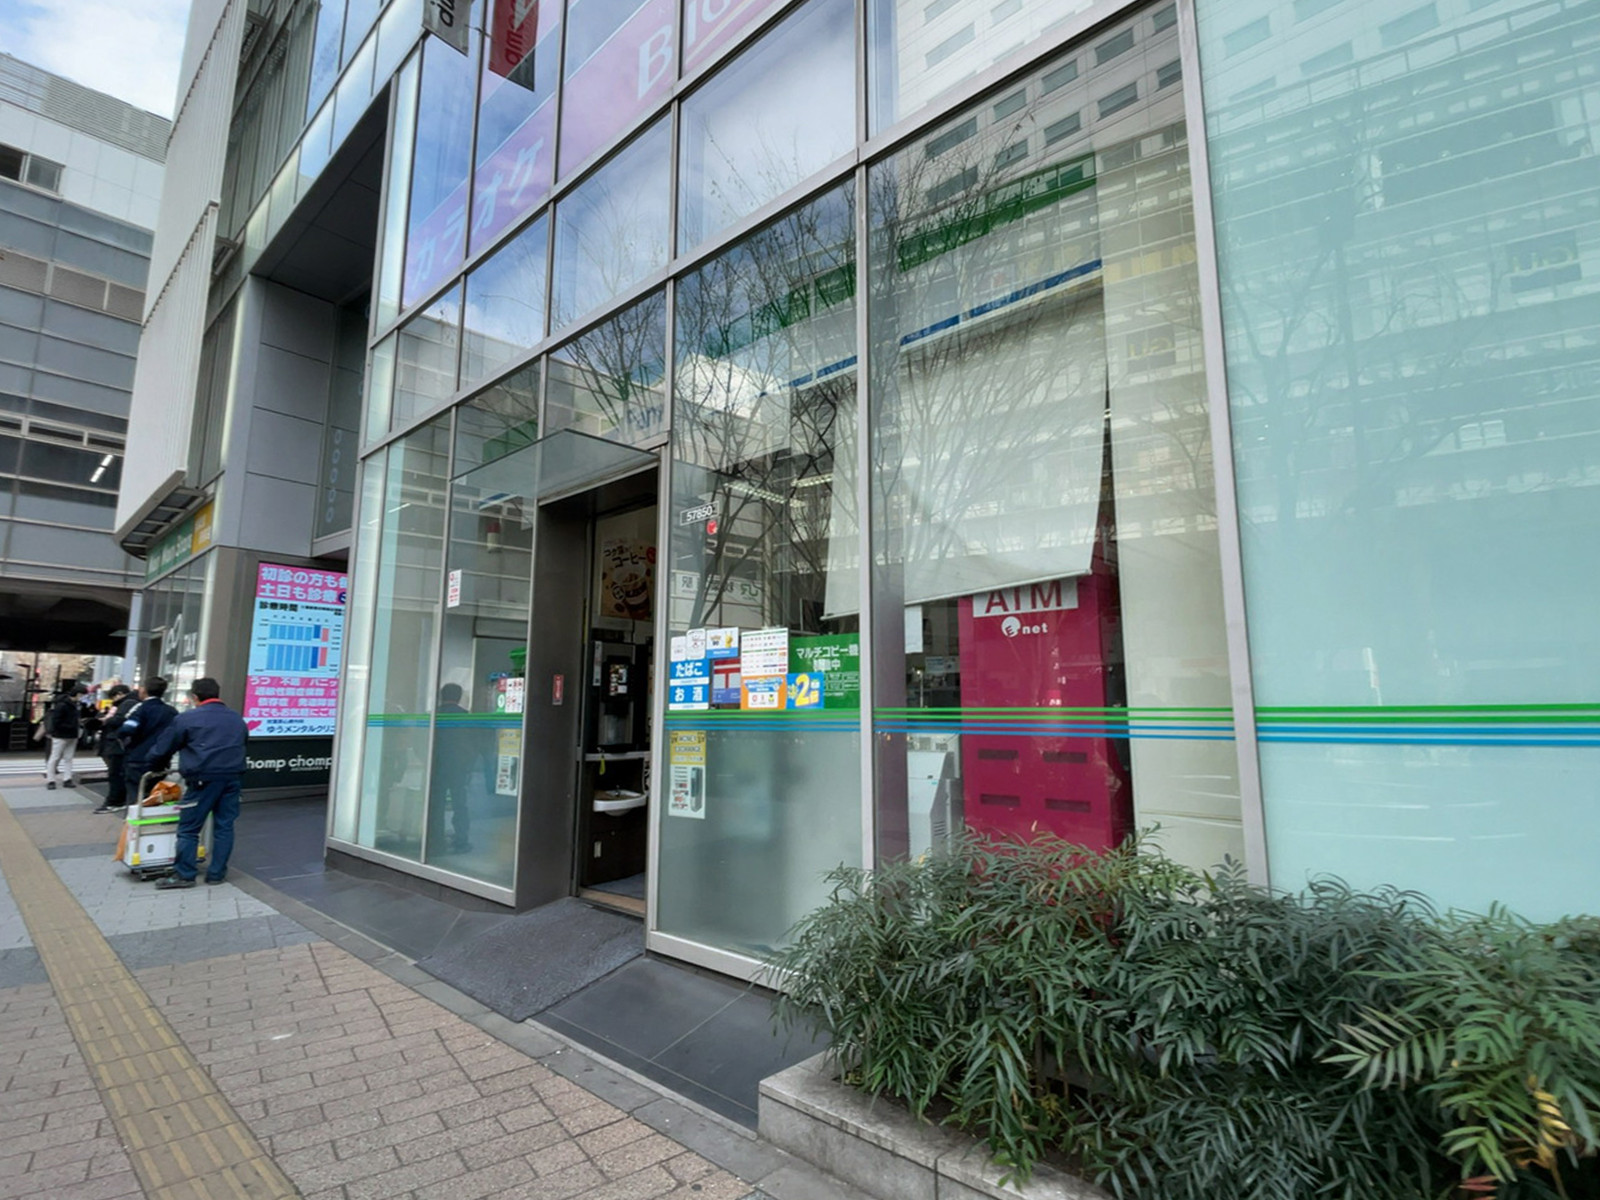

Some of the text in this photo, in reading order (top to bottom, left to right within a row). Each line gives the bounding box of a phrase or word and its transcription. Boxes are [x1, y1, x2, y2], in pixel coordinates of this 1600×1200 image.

[611, 552, 647, 569] コーヒー
[675, 661, 703, 678] たばこ
[245, 757, 286, 772] homp
